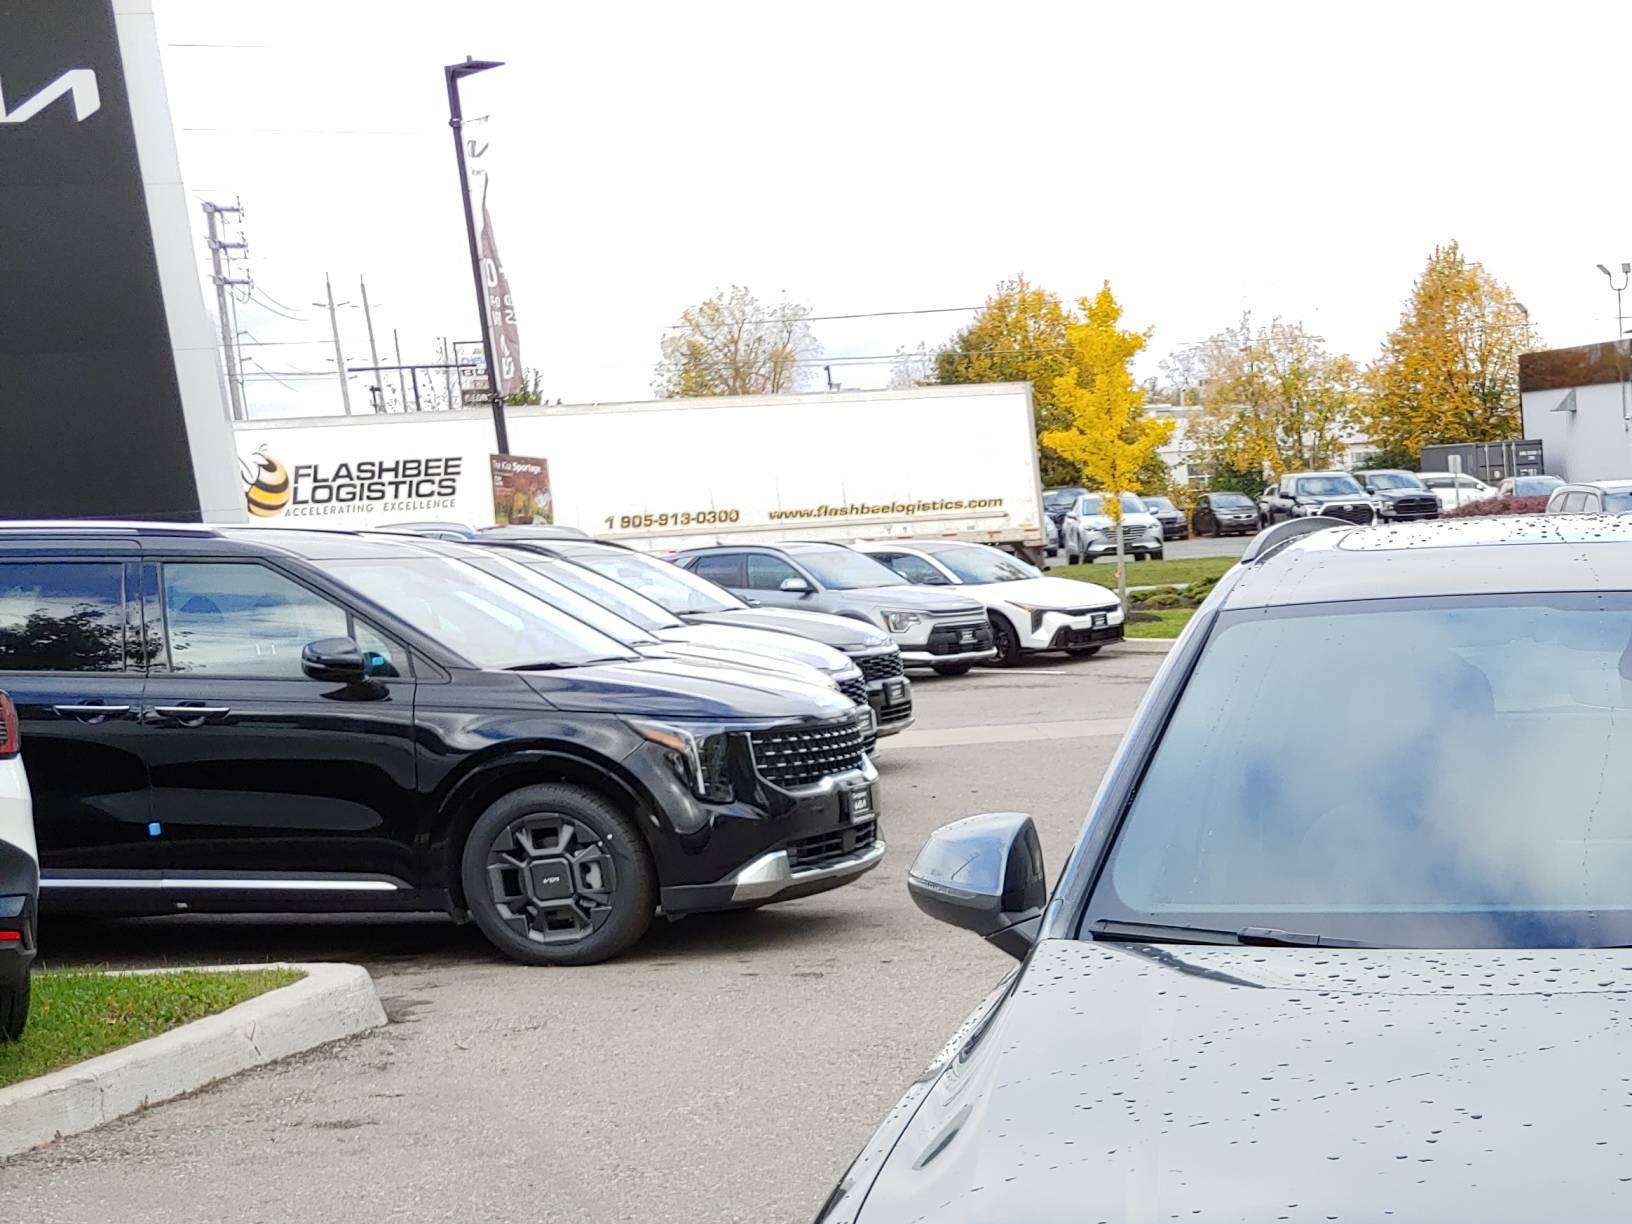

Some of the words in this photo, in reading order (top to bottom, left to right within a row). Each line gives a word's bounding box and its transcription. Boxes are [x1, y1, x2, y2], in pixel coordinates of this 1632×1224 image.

[293, 457, 462, 485] FLASHBEE
[292, 478, 457, 505] LOGISTICS
[284, 504, 374, 517] ACCELERATING
[384, 499, 457, 512] EXCELLENCE
[605, 516, 615, 529] 1
[620, 509, 740, 529] 905-913-0300
[768, 498, 1003, 520] www.flashbeelogistics.com
